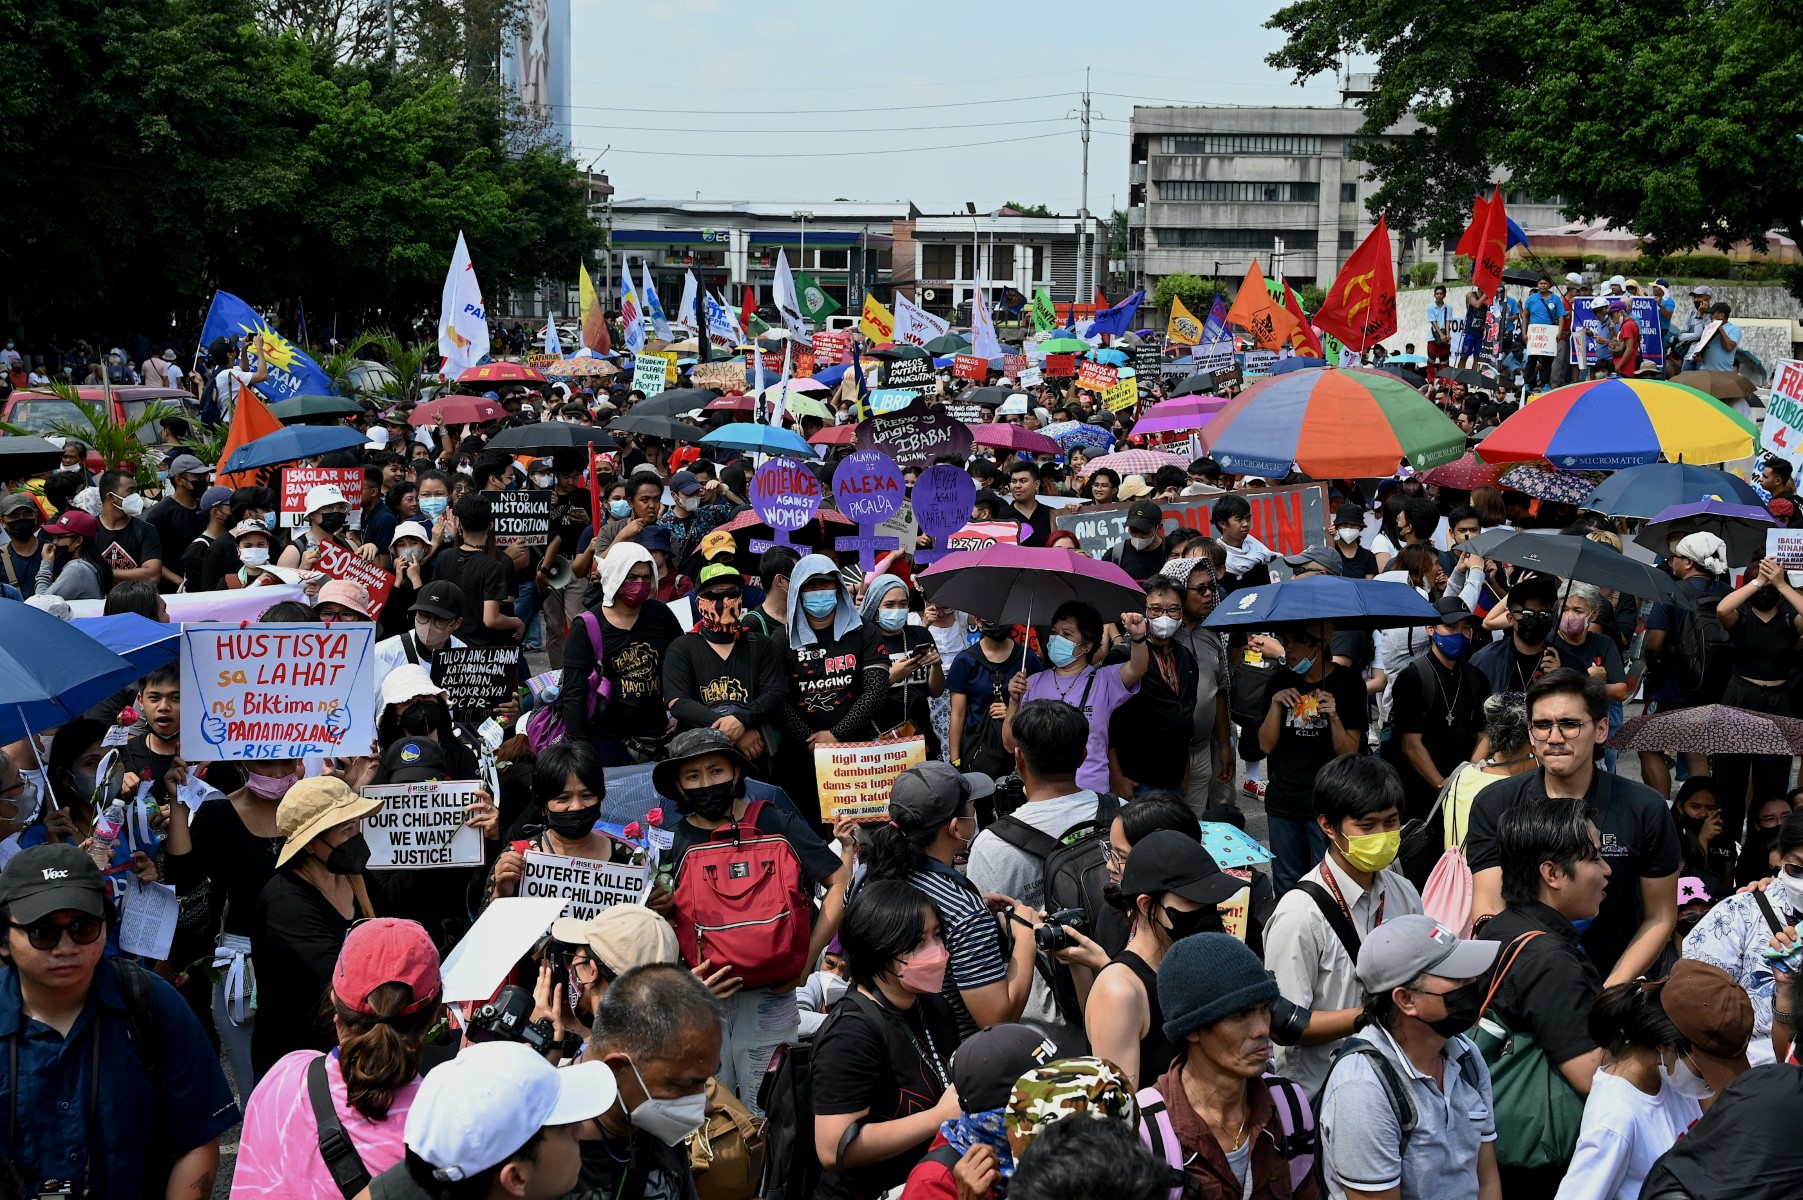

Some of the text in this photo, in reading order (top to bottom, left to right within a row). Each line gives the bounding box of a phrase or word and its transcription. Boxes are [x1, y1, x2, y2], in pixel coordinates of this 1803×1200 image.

[1632, 301, 1652, 310] ASADA,
[638, 357, 666, 366] STUDENT
[891, 358, 924, 369] MARCOS
[957, 356, 979, 366] MARCOS
[637, 364, 665, 374] WELFARE
[891, 364, 928, 376] DUTERTE
[1083, 362, 1108, 375] MARCOS
[635, 379, 661, 390] PROFIT
[888, 372, 935, 385] PANAGUTIN!
[922, 415, 935, 424] ng
[850, 453, 880, 465] PALAYAIN
[1426, 444, 1462, 462] MICROMATIC
[777, 458, 796, 469] END
[1234, 458, 1283, 472] MICROMATIC
[1579, 456, 1644, 466] MICROMATIC
[286, 470, 359, 482] ISKOLAR NG
[756, 467, 819, 499] VIOLENCE
[931, 469, 958, 492] NEVER
[840, 475, 899, 496] ALEXA
[501, 493, 529, 502] NO TO
[776, 495, 814, 508] AGAINST
[934, 491, 958, 502] AGAIN
[491, 502, 549, 514] HISTORICAL
[849, 495, 894, 518] PACALDA
[762, 506, 809, 528] WOMEN
[918, 510, 950, 532] MARTIAL
[494, 518, 549, 532] ISTORTION
[1075, 520, 1108, 540] ANG
[320, 540, 351, 575] 750
[350, 557, 388, 581] NATIONAL
[347, 565, 384, 590] MINIMUM
[216, 634, 348, 660] HUSTISYA
[439, 648, 519, 665] TULOY ANG LABAN!
[798, 649, 826, 661] STOP
[446, 663, 505, 677] KATARUNGAN,
[825, 654, 856, 674] RED
[217, 670, 248, 687] sa
[441, 674, 492, 686] KALAYAAN,
[799, 675, 853, 692] TAGGING
[448, 685, 506, 697] EMOKRASYA!
[621, 679, 645, 693] MAYO
[212, 697, 236, 718] ng
[318, 698, 339, 716] ng
[227, 720, 347, 745] PAMAMASLANG!
[832, 750, 908, 765] Itigil ang mga
[834, 763, 907, 778] dambuhalang
[823, 776, 896, 790] dams sa lupai
[834, 792, 891, 805] mga katut
[368, 814, 398, 828] OUR
[390, 830, 454, 845] WE WANT
[391, 848, 452, 864] JUSTICE!
[526, 863, 643, 892] DUTERTE KILLED
[528, 882, 558, 898] OUR
[560, 905, 568, 918] E
